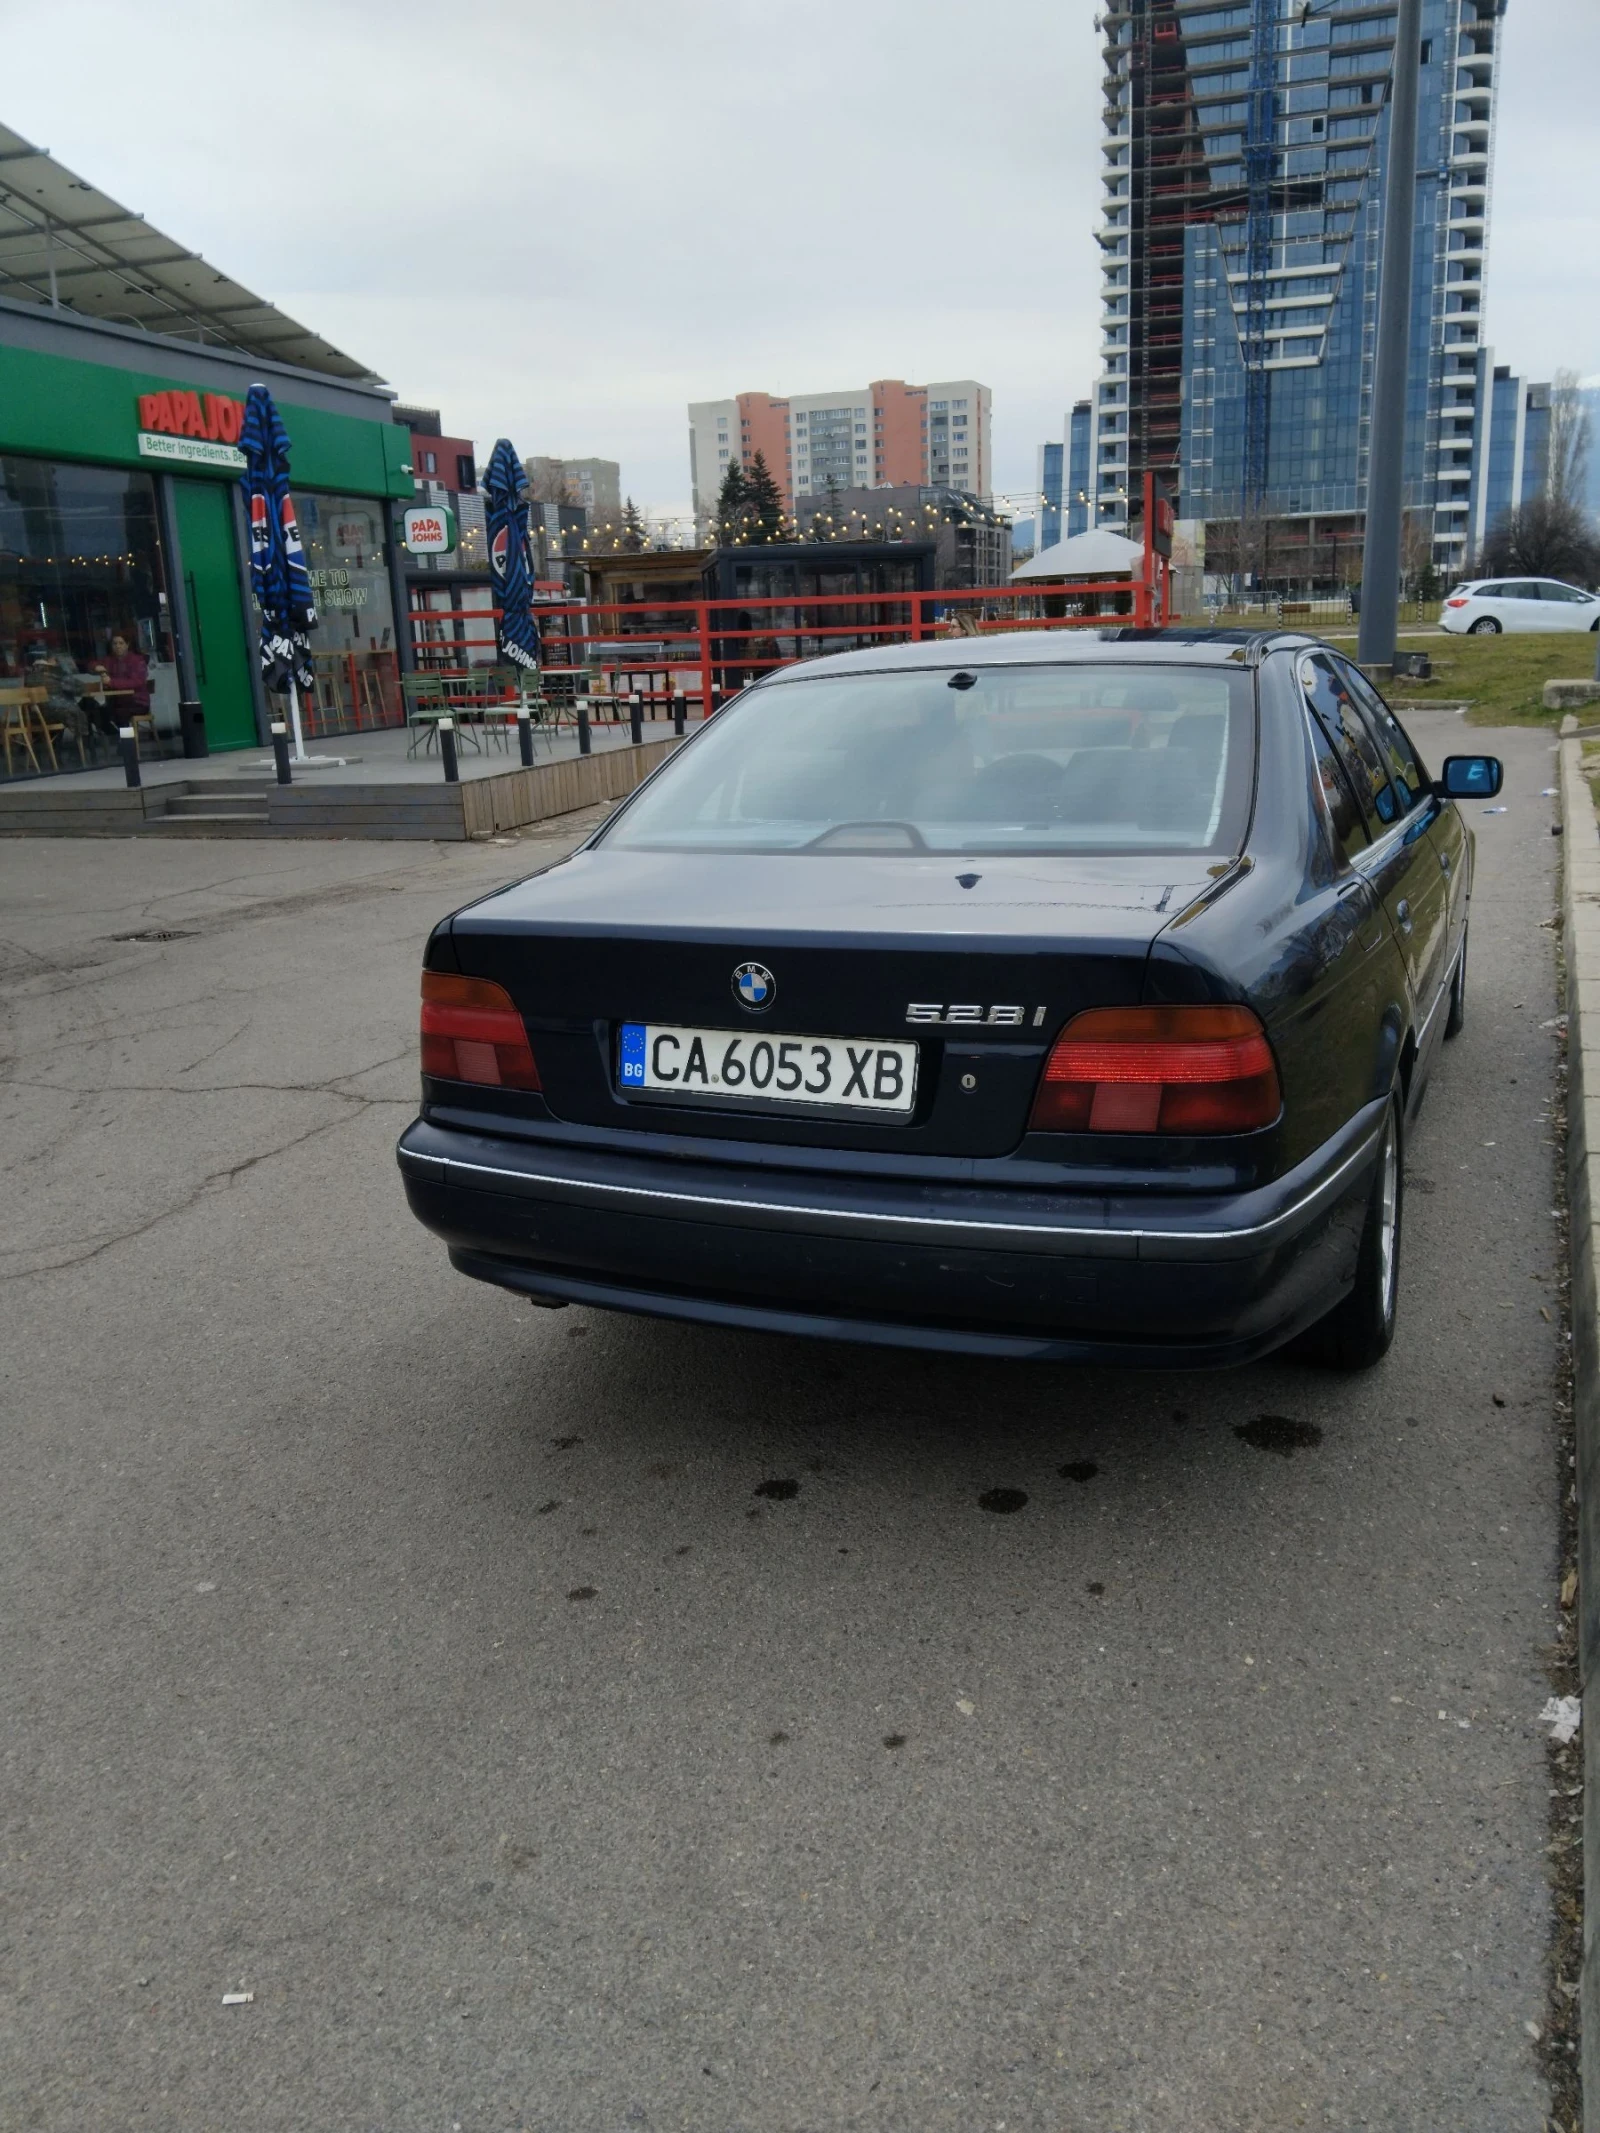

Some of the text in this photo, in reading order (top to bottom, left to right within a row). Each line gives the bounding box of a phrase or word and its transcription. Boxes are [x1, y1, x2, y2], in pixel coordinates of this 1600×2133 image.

[140, 390, 209, 438] PAPA
[146, 436, 176, 452] Better
[178, 442, 231, 461] Ingredients.
[412, 519, 441, 532] PAPA
[412, 532, 442, 543] JOHNS
[329, 568, 349, 586] TO
[324, 587, 367, 607] SHOW
[502, 640, 536, 669] JOHNS
[735, 965, 770, 981] BMW
[624, 1062, 643, 1078] BG
[651, 1034, 904, 1100] CA 6053 XB
